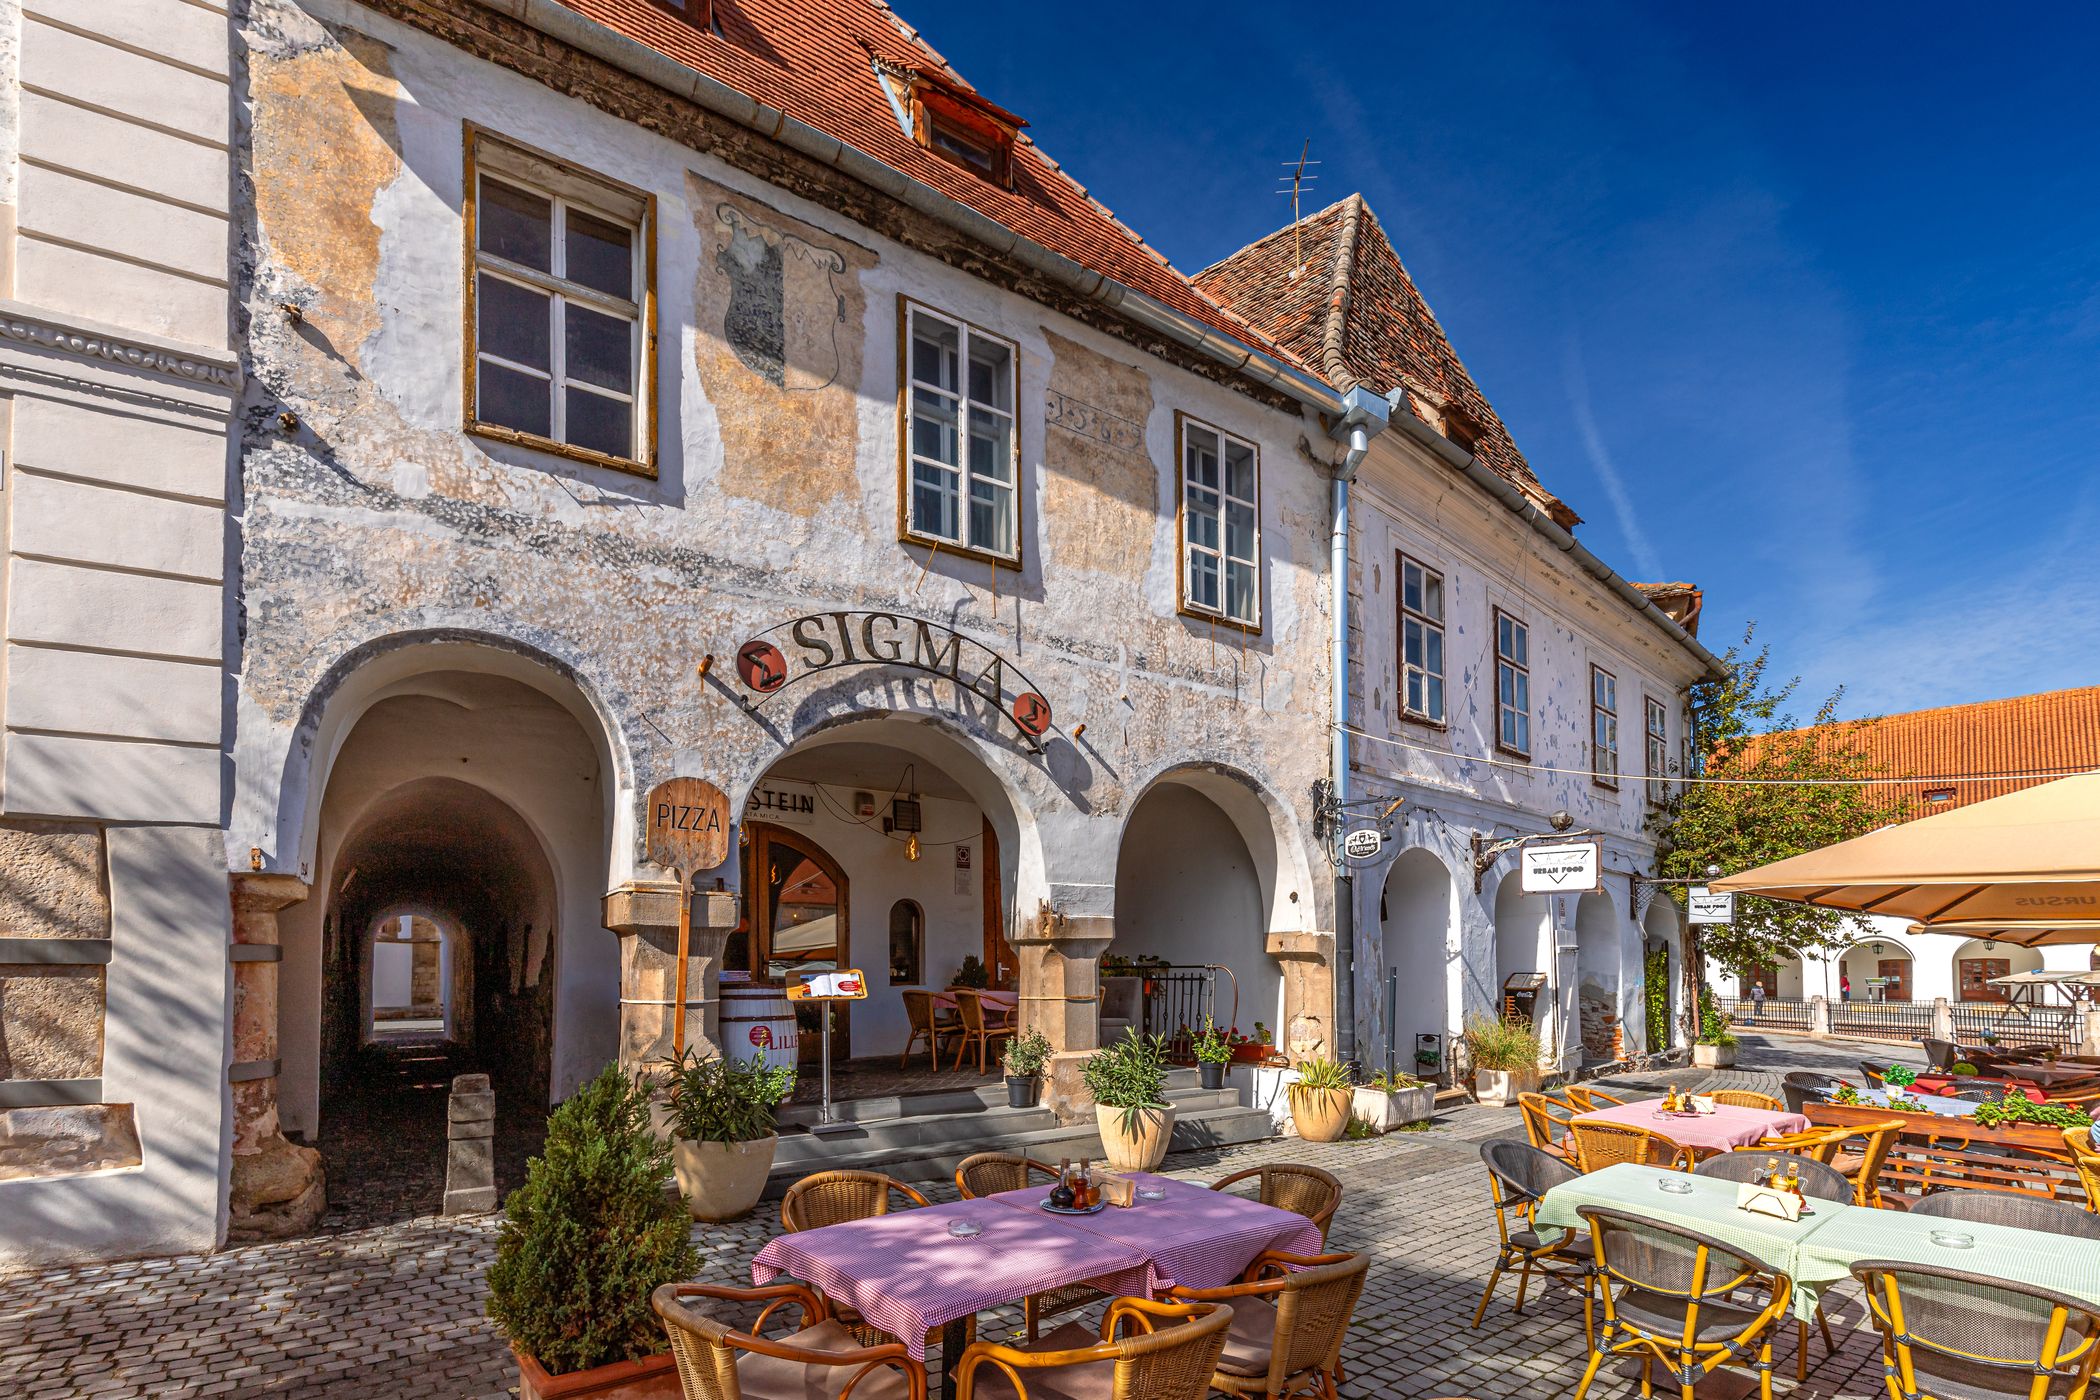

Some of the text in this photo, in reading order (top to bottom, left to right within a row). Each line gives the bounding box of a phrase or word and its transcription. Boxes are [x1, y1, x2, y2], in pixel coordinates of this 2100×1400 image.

[792, 611, 1004, 700] SIGMA
[745, 786, 814, 814] STEIN
[657, 803, 720, 832] PIZZA
[1533, 867, 1558, 875] URBAN
